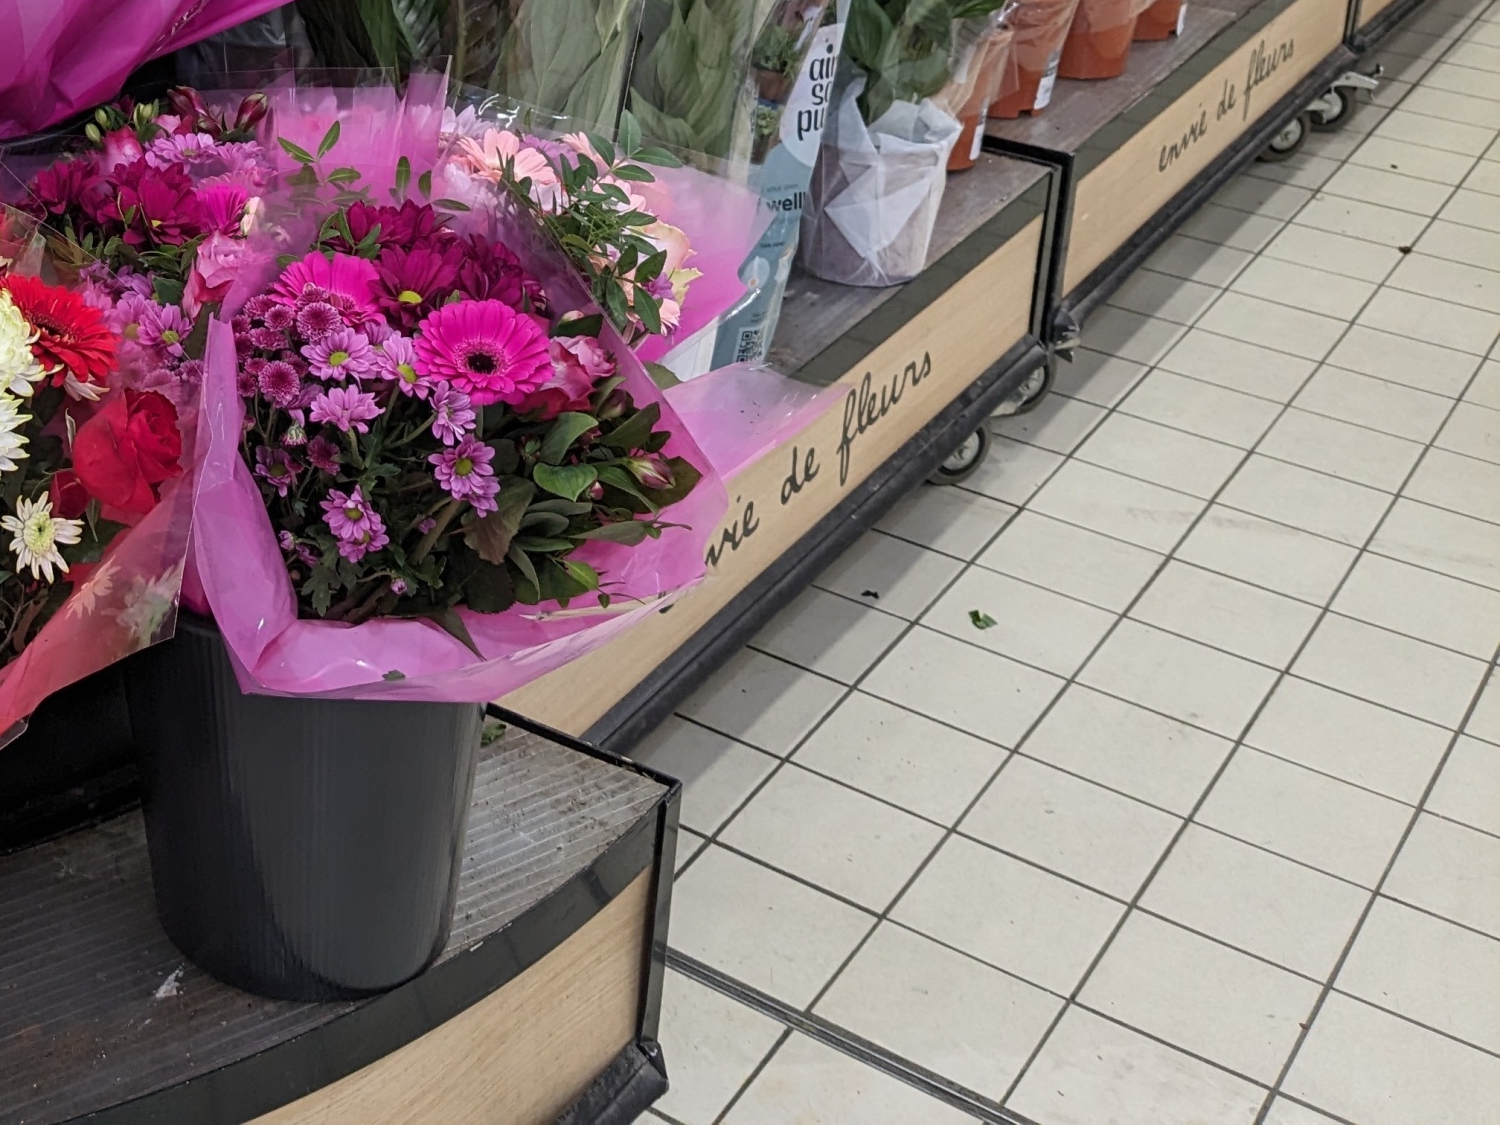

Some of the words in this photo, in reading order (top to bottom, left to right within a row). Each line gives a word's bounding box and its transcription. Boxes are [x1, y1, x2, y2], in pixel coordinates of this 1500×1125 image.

[1159, 102, 1208, 172] envie
[1216, 79, 1236, 121] de
[1243, 39, 1294, 122] fleurs
[781, 446, 820, 505] de
[836, 351, 932, 487] fleurs
